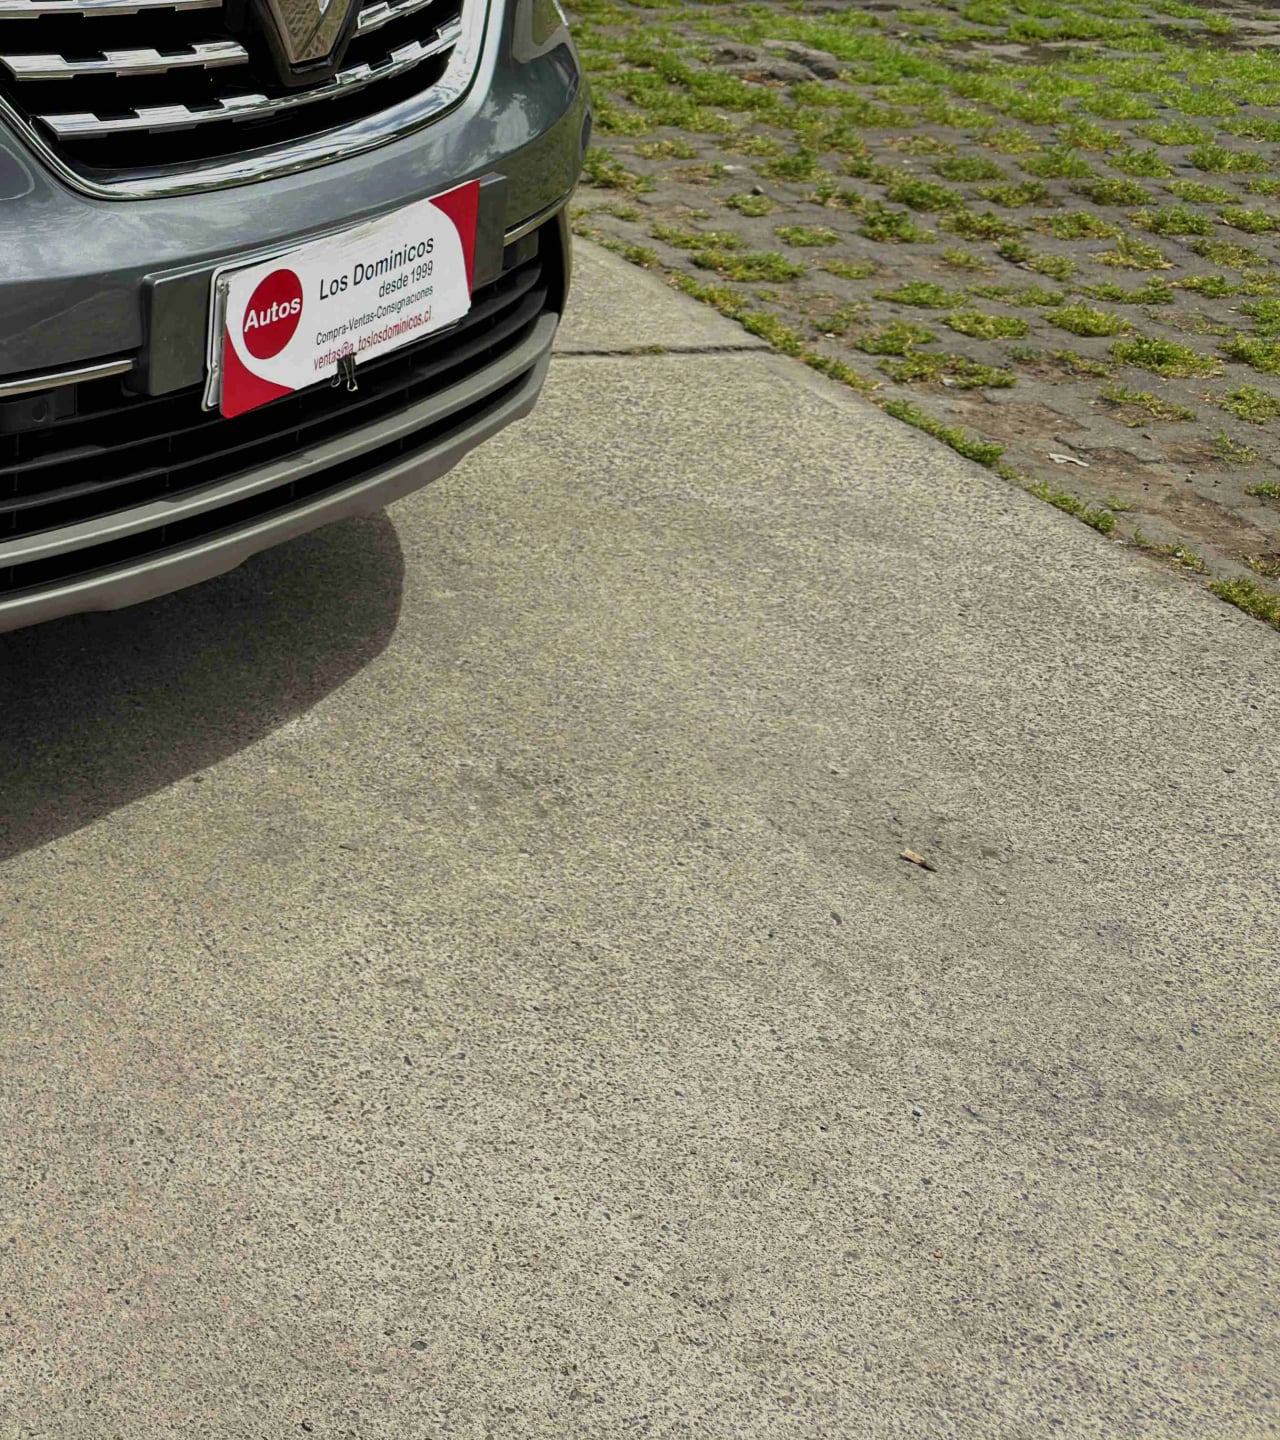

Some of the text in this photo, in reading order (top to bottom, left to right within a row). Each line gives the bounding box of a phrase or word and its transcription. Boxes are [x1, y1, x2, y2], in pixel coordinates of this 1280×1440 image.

[319, 237, 435, 301] Los Dominicos
[378, 260, 434, 298] desde 1999
[243, 297, 302, 332] Autos
[313, 306, 432, 371] ventas@atoslosdominicos.cl
